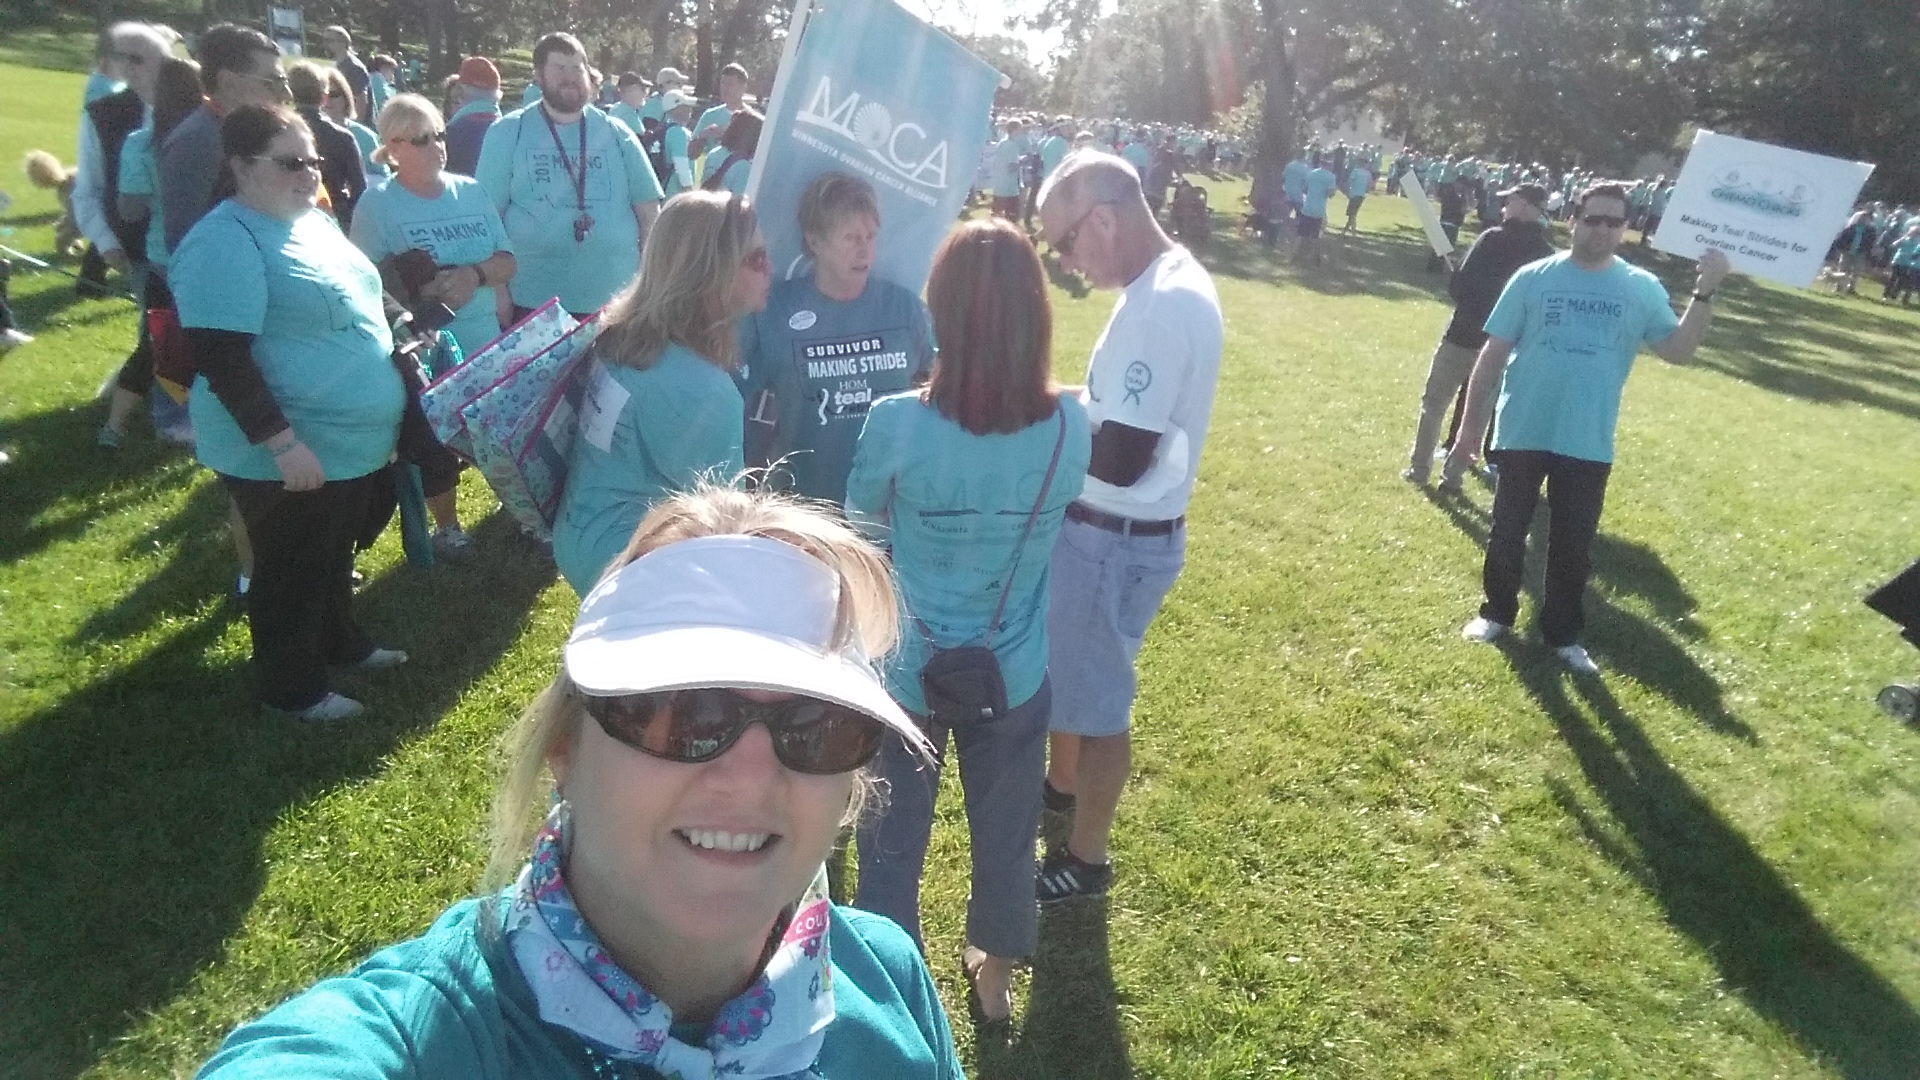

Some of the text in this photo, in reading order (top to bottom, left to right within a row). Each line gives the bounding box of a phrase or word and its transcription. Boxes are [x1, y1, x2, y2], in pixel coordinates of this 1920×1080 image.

[800, 75, 947, 188] MOCA
[792, 128, 839, 158] MINNESOTA
[840, 152, 875, 176] OVARIAN
[431, 222, 488, 242] MAKING
[1680, 214, 1808, 254] Making Teal Strides for
[1695, 234, 1779, 262] Ovarian Cancer
[1545, 297, 1563, 327] 2015
[1567, 298, 1622, 318] MAKING
[806, 339, 882, 358] SURVIVOR
[808, 351, 908, 379] MAKING STRIDES
[834, 388, 872, 406] teal
[839, 379, 868, 390] HOM
